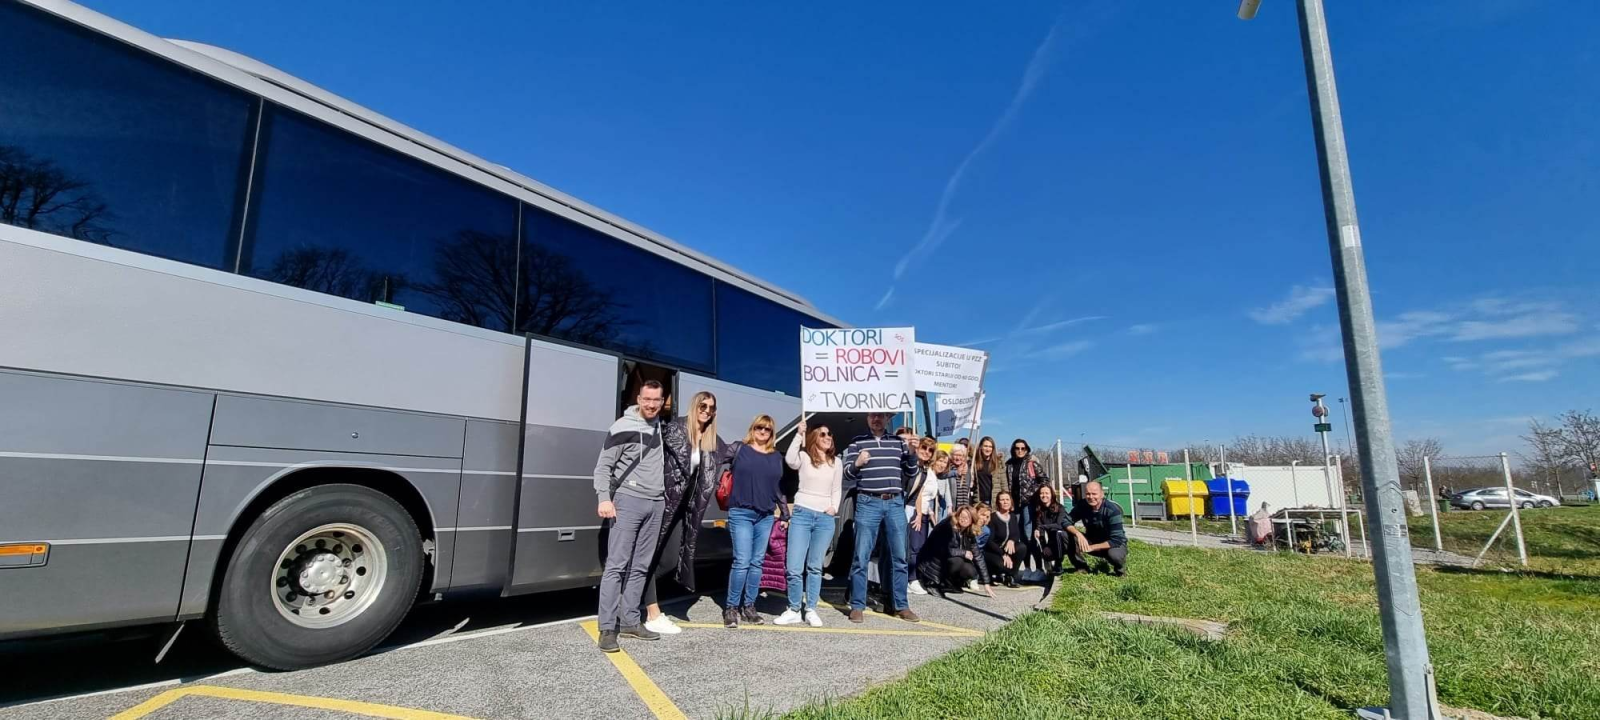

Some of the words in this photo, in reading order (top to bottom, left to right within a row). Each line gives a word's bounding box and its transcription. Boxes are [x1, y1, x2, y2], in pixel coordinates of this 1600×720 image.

[802, 328, 882, 346] DOKTORI
[835, 348, 905, 366] ROBOVI
[914, 348, 965, 360] SPECIJALIZACIJE
[803, 365, 881, 382] BOLNICA
[820, 391, 912, 410] TVORNICA
